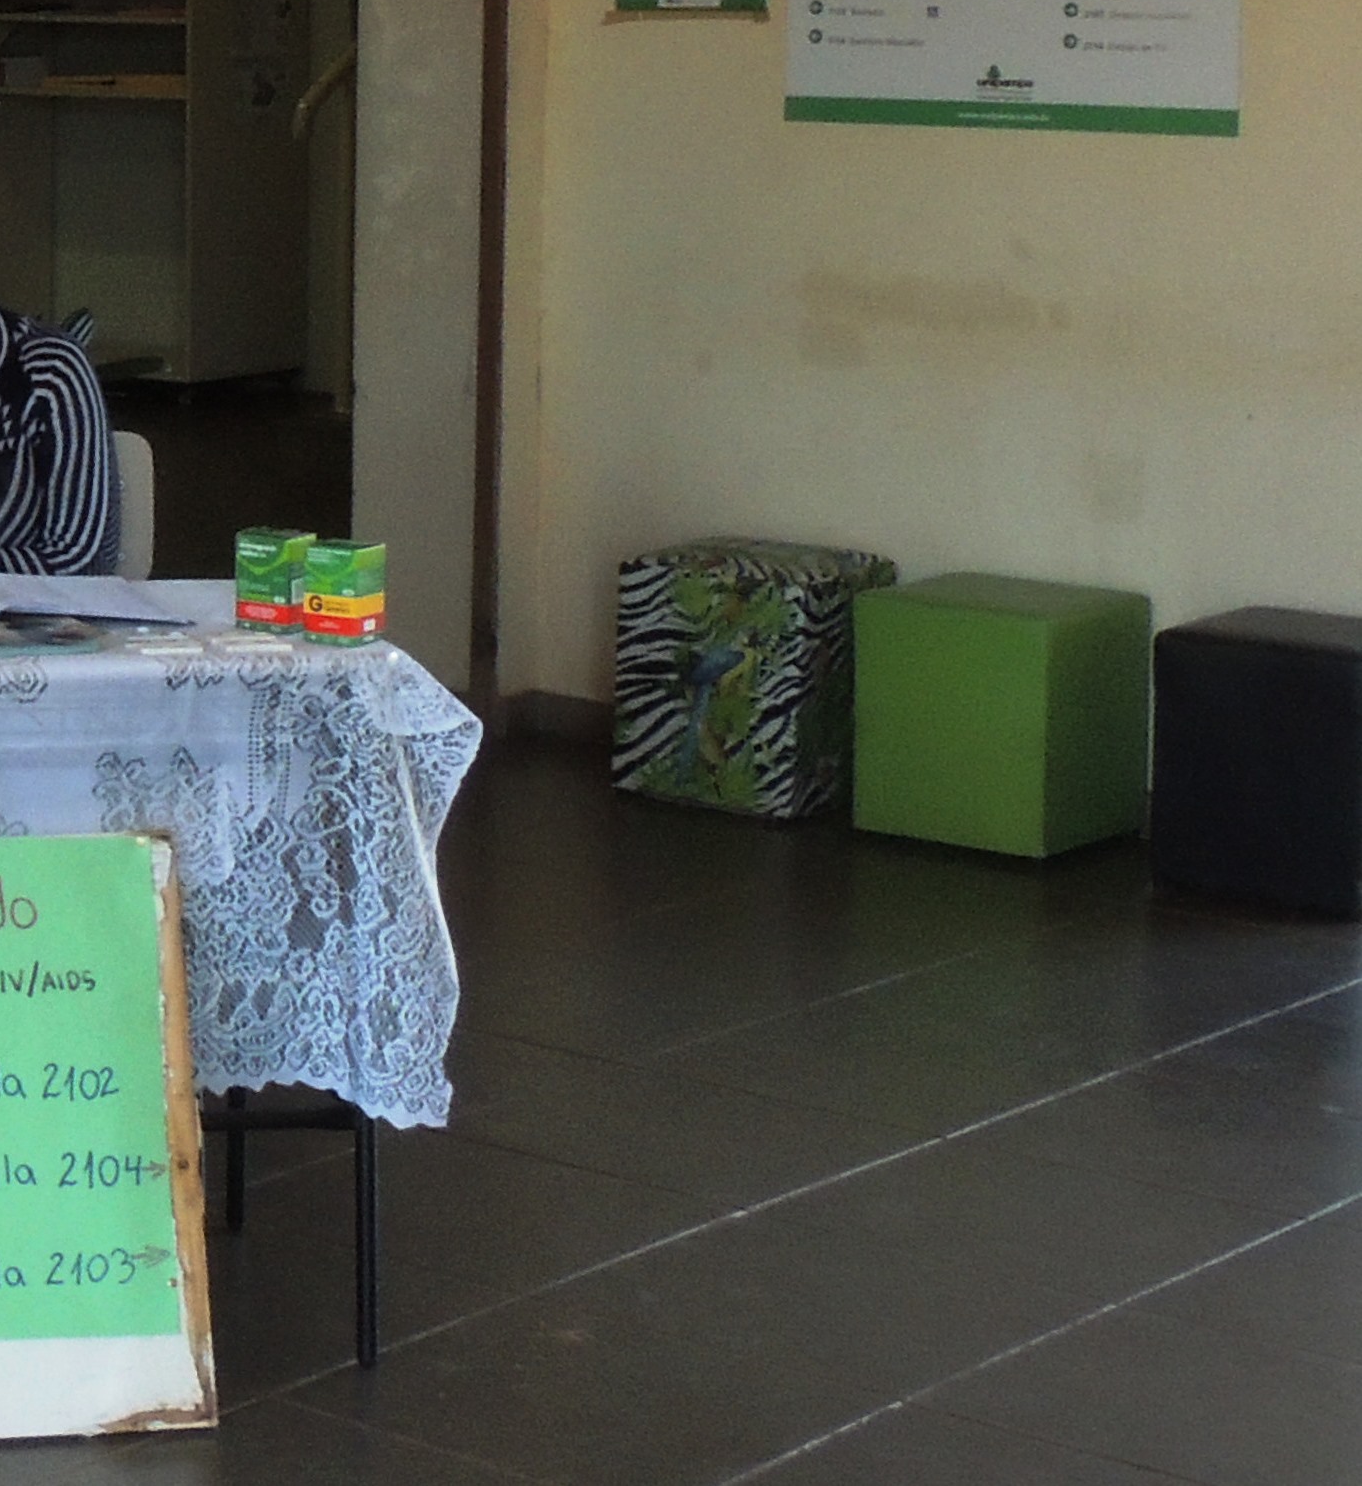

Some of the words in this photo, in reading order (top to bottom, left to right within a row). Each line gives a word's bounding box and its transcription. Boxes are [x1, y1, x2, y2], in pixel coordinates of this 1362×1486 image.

[308, 595, 323, 612] G
[41, 1062, 120, 1103] 2102
[57, 1150, 144, 1189] 2104
[45, 1246, 136, 1287] 2103
